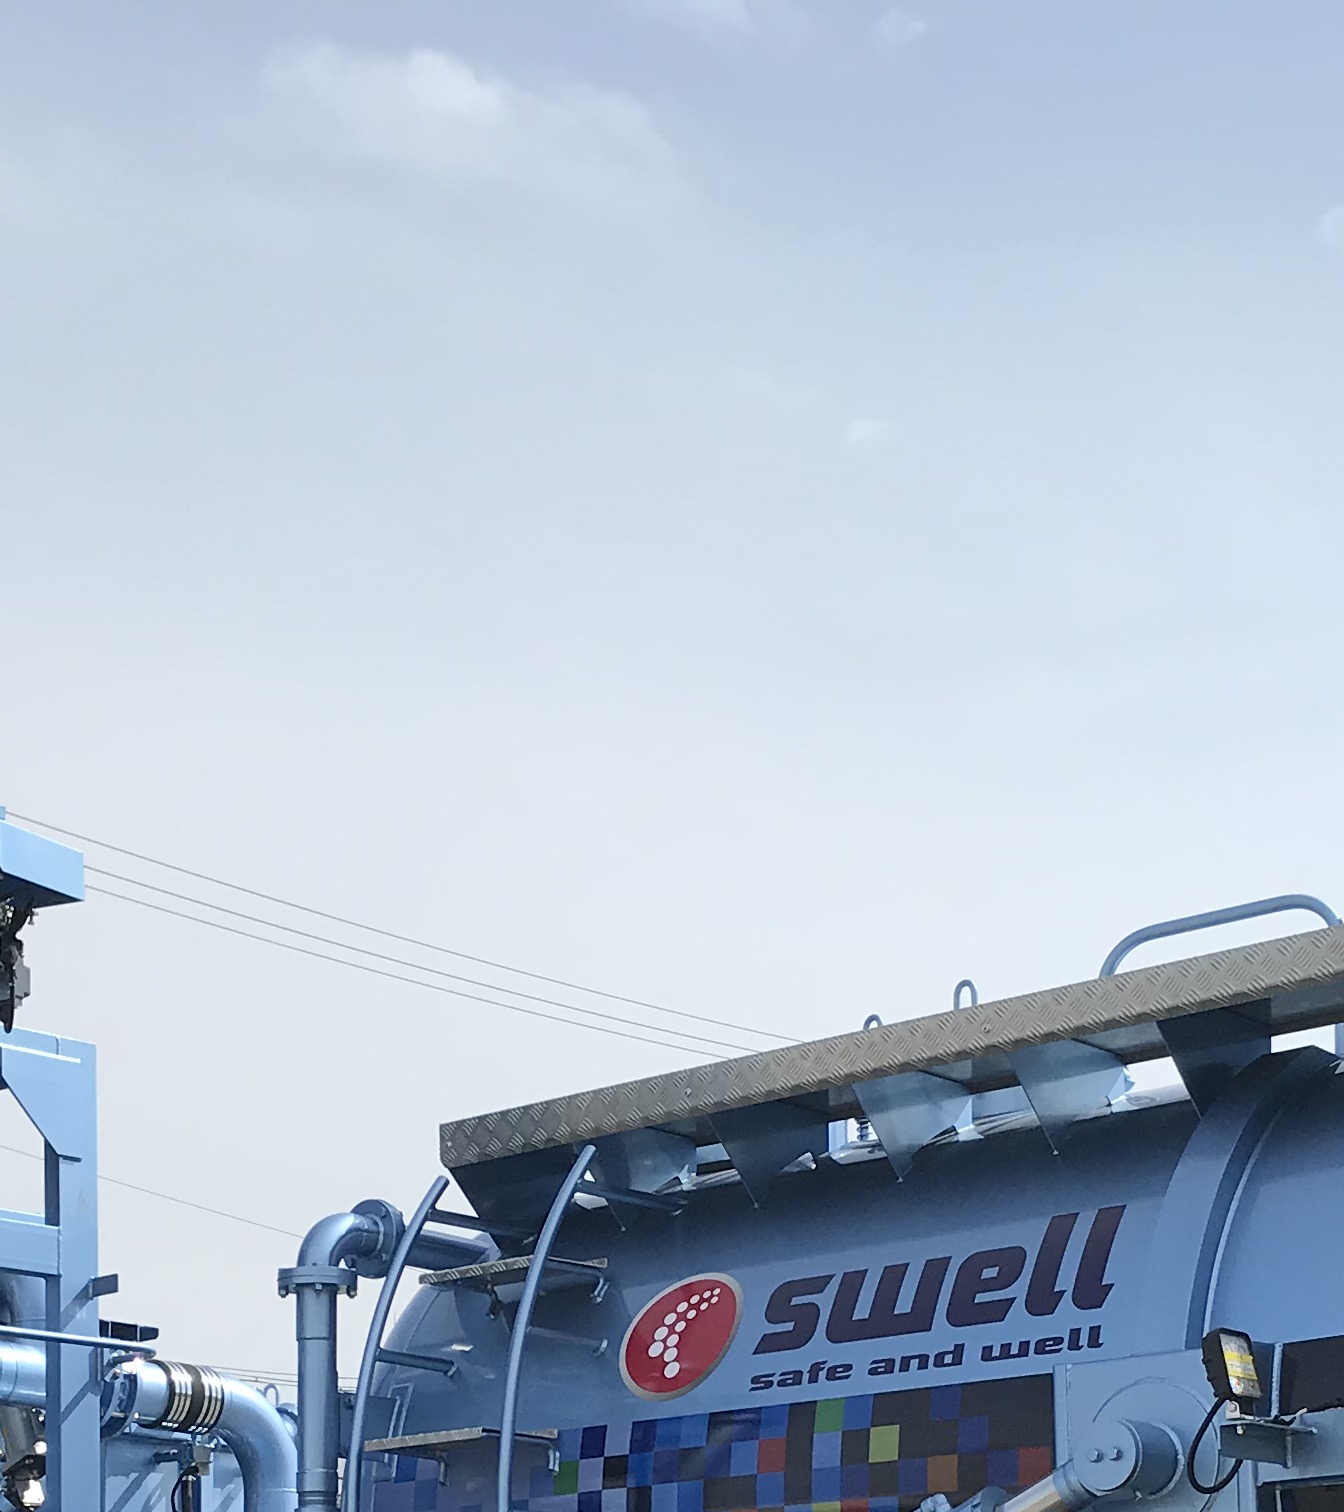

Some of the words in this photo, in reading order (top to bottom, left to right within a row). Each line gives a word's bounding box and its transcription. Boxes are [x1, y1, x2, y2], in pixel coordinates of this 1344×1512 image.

[752, 1204, 1127, 1356] swell
[748, 1359, 854, 1392] safe
[867, 1342, 965, 1377] and
[980, 1324, 1104, 1362] well
